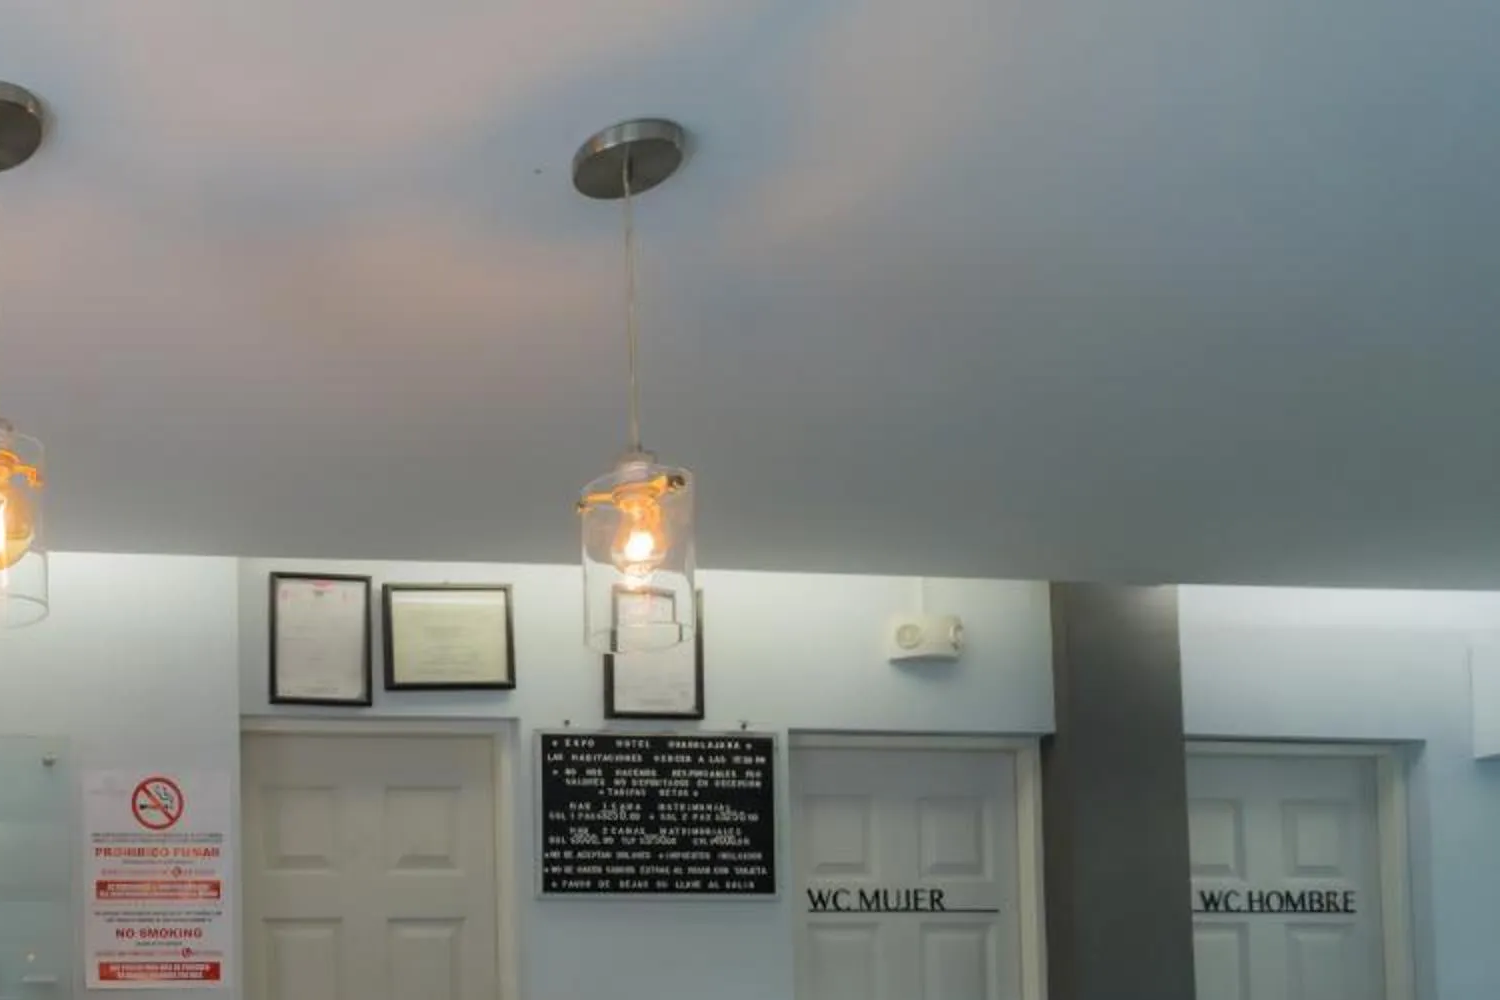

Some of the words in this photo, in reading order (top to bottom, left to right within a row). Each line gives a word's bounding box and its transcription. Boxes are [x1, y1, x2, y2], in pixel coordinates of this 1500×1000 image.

[95, 847, 170, 857] PROHIBIDO
[807, 887, 850, 911] WC
[858, 887, 945, 912] MUJER
[1199, 889, 1241, 912] WC
[1246, 889, 1357, 913] HOMBRE
[115, 927, 135, 939] NO
[139, 927, 203, 939] SMOKING
